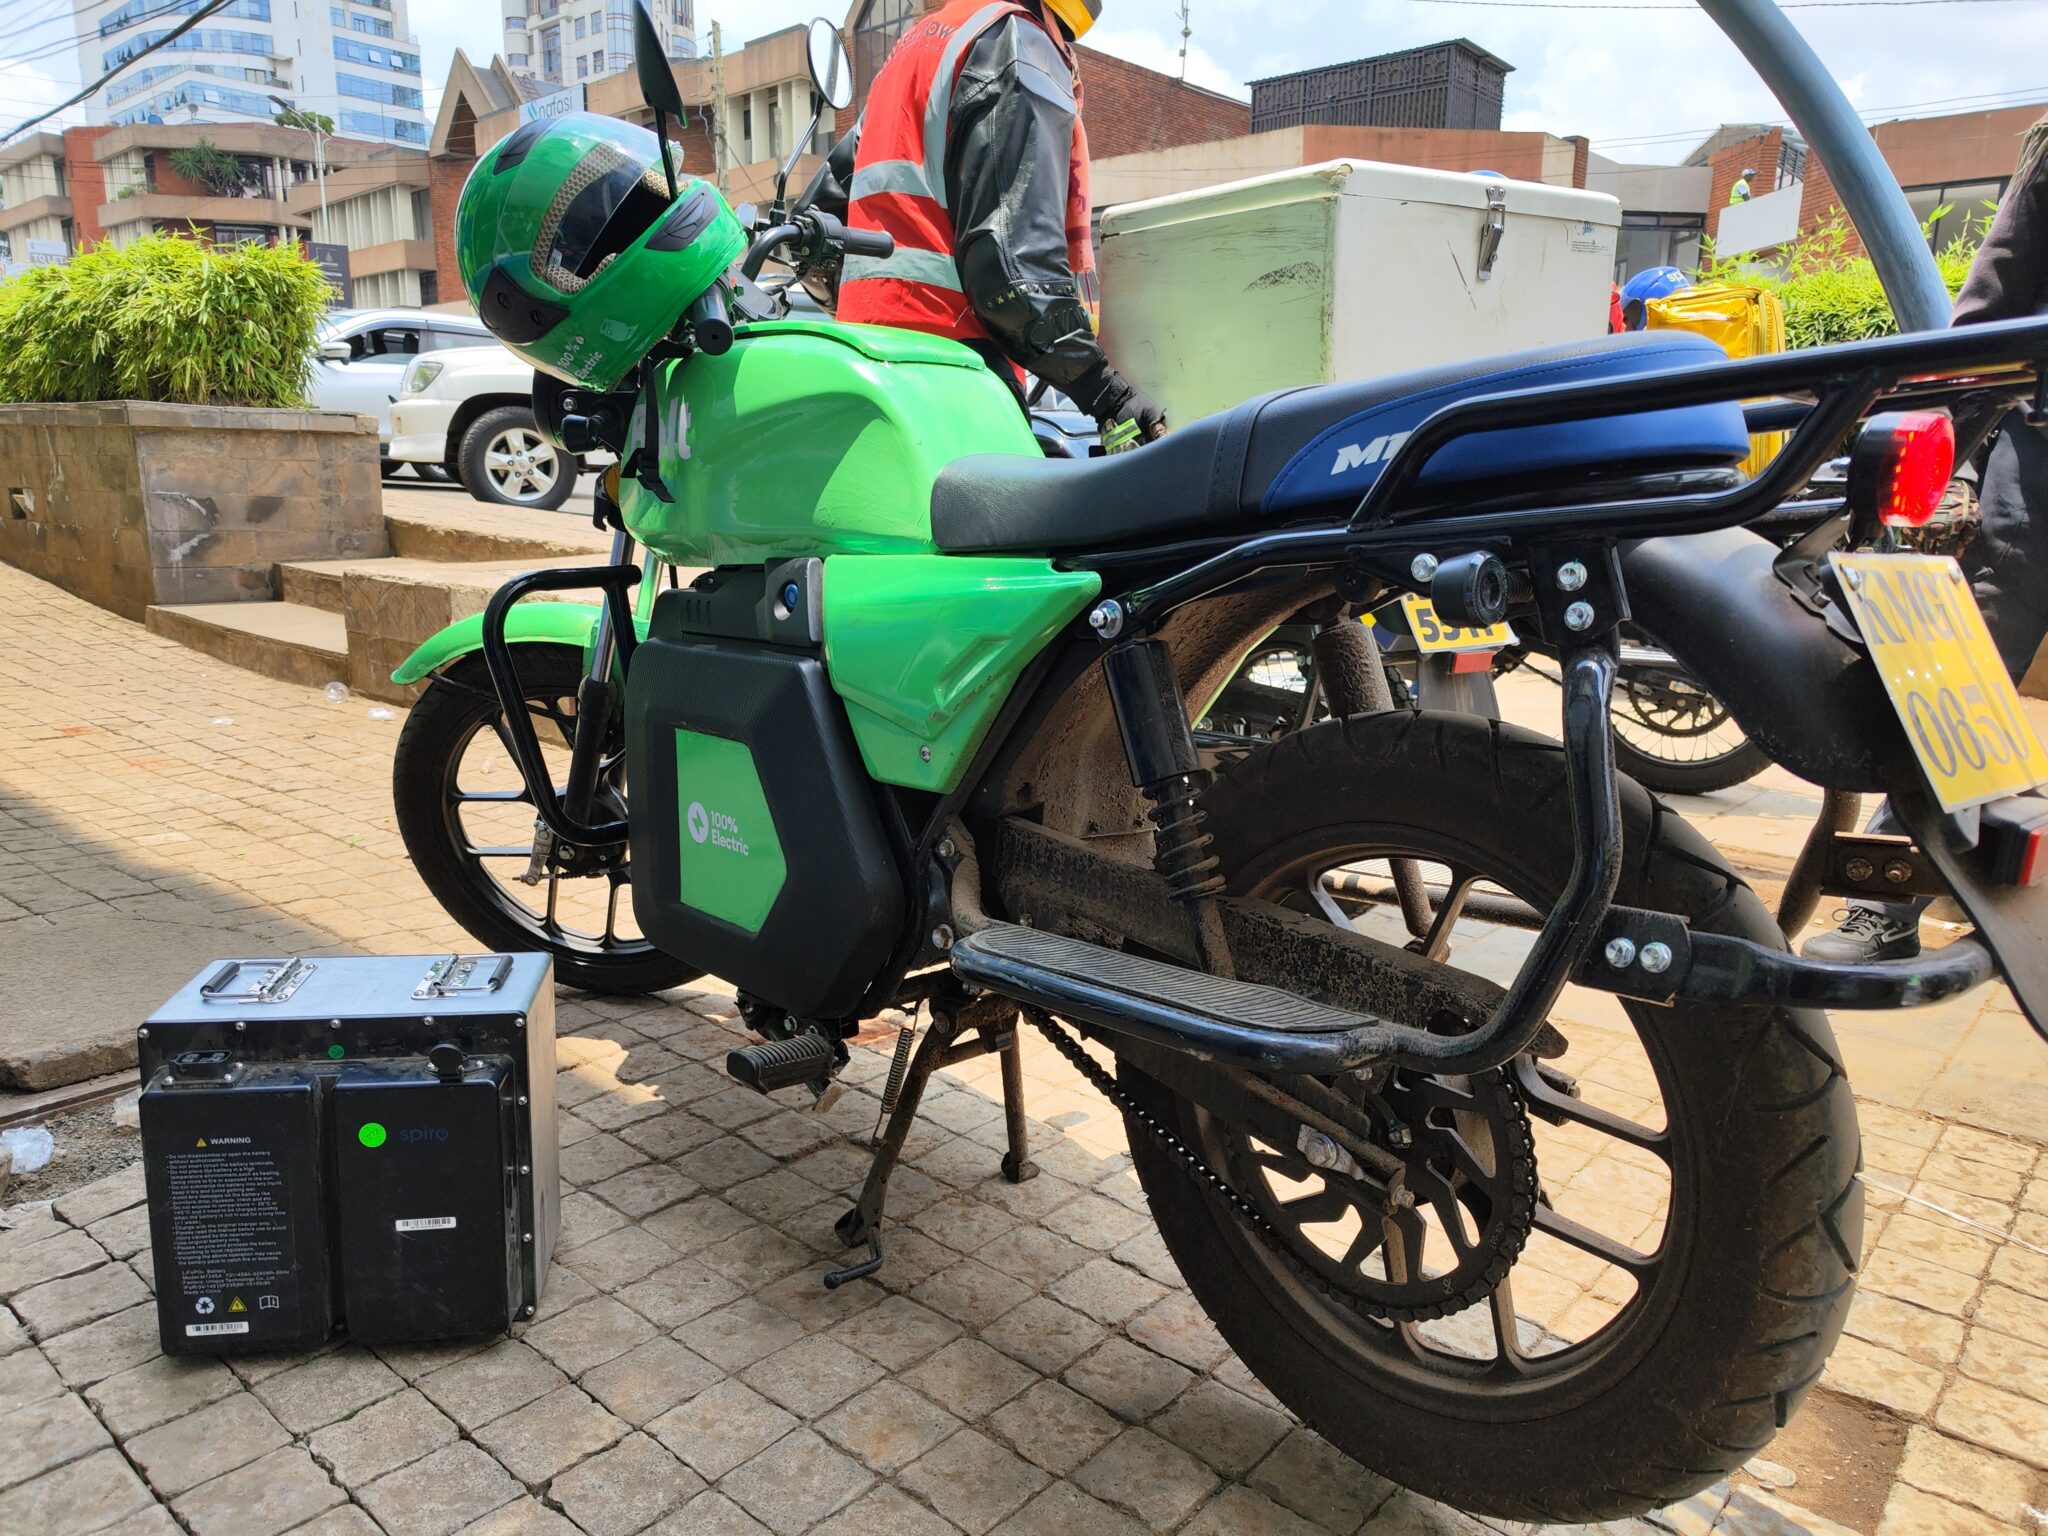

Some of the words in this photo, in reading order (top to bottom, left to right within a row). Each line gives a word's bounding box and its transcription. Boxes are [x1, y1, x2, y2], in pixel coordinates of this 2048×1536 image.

[539, 89, 573, 119] nafasi
[32, 254, 46, 262] TO
[557, 341, 581, 368] 100%
[711, 810, 739, 834] 100%
[712, 829, 750, 857] Electric
[210, 1137, 251, 1145] WARNING
